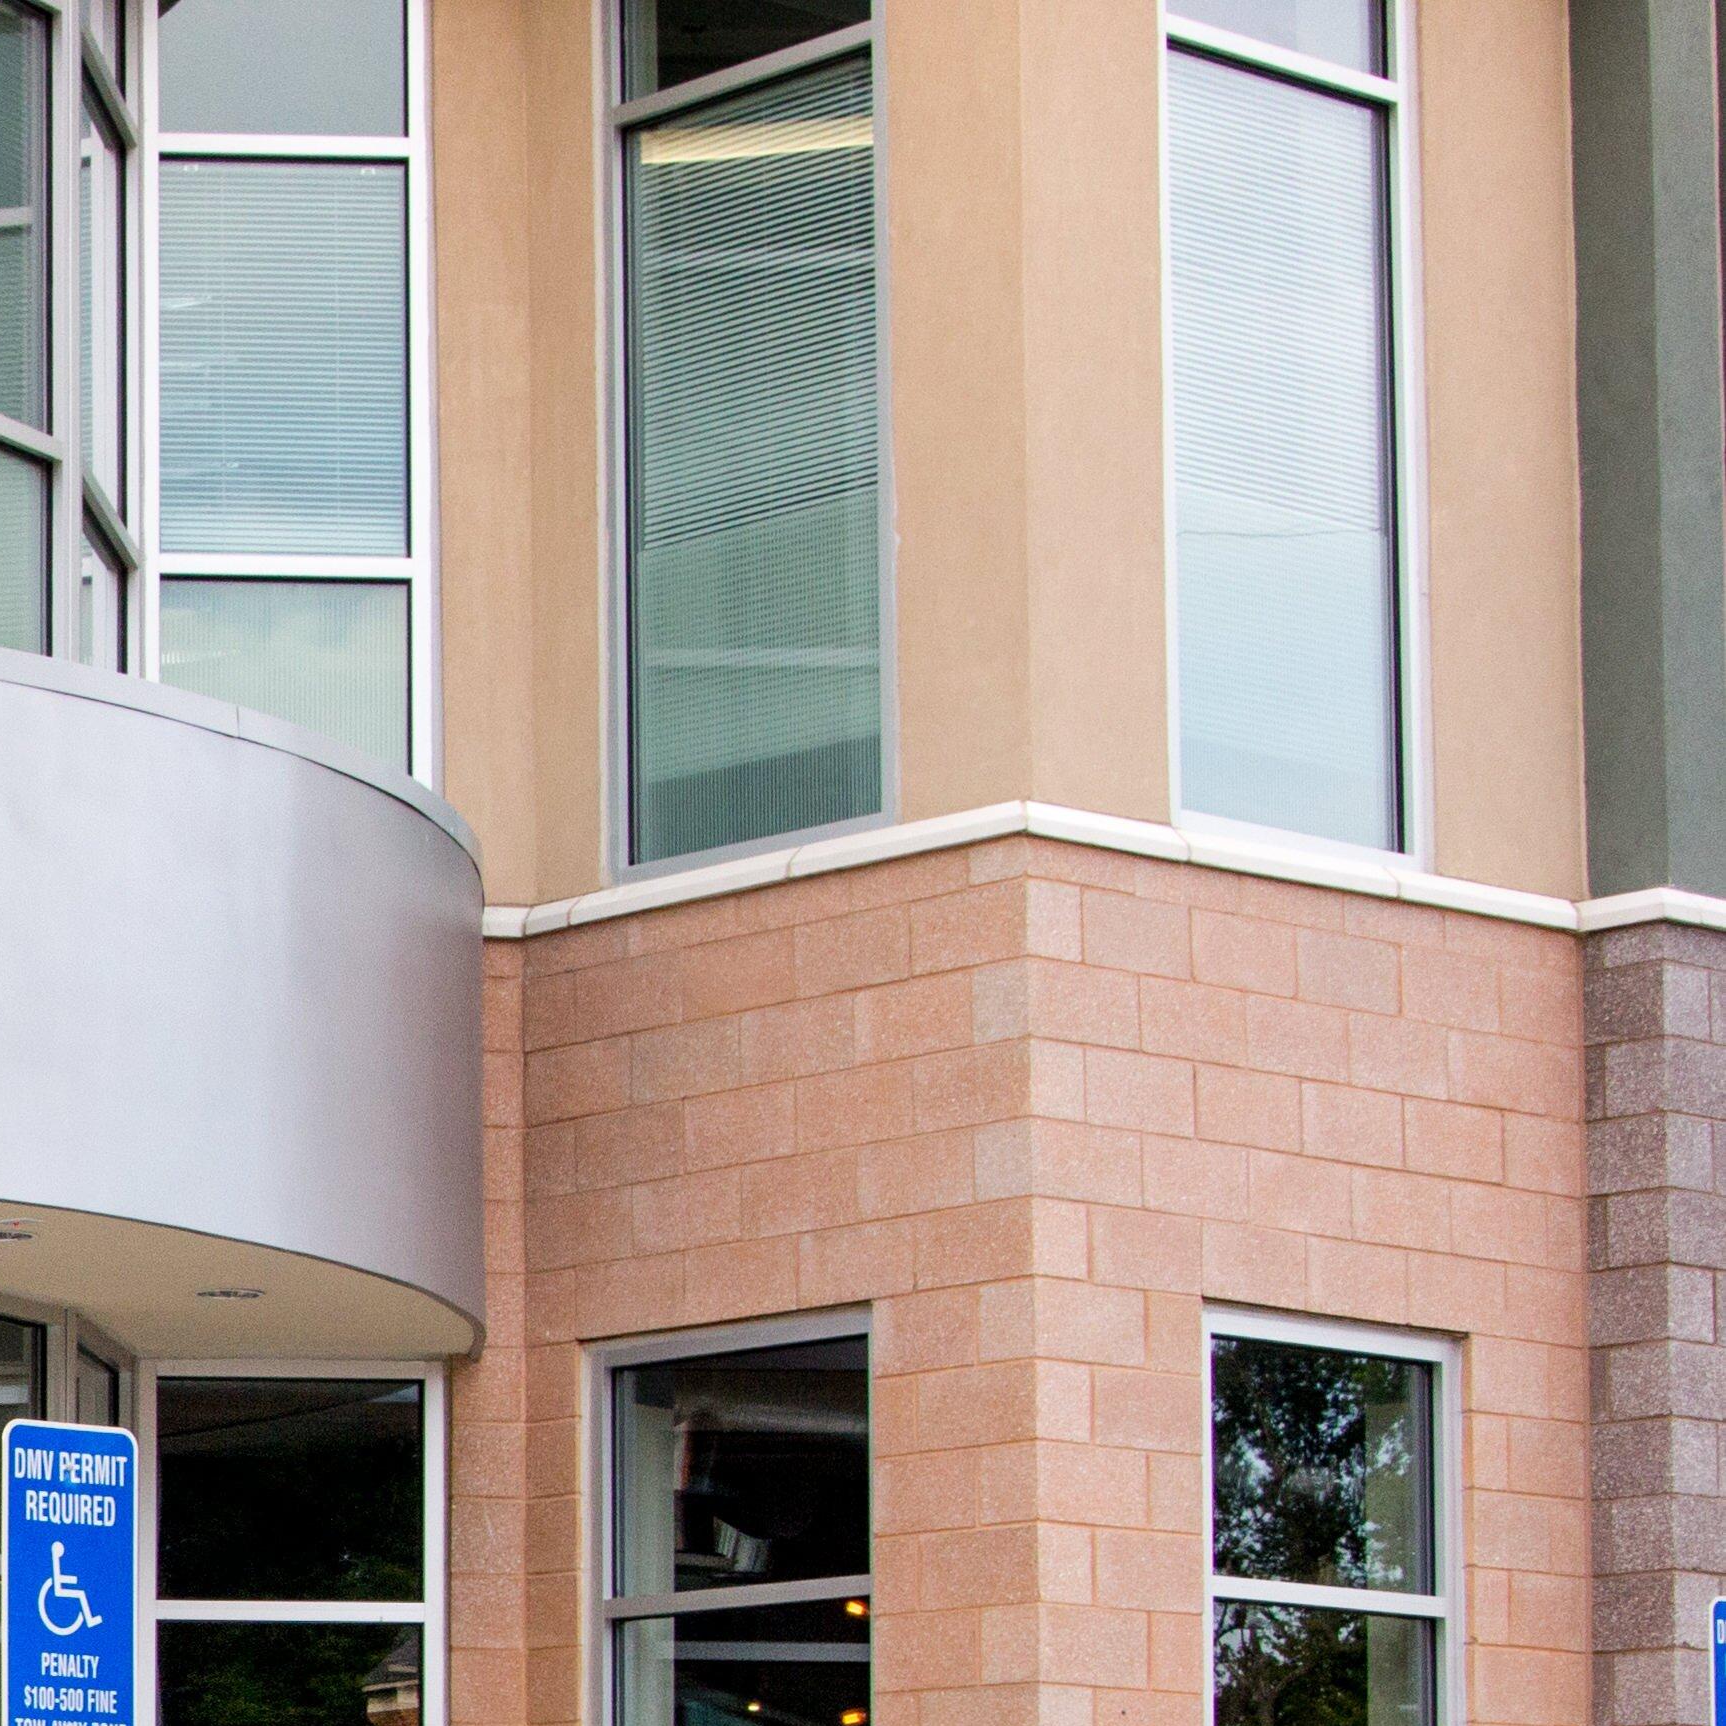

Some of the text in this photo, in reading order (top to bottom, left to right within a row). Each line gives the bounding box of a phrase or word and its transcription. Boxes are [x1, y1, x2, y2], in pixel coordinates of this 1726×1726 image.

[15, 1448, 127, 1487] DMV PERMIT
[25, 1491, 116, 1527] REQUIRED
[41, 1653, 99, 1678] PENALTY
[24, 1686, 117, 1713] $100-500 FINE
